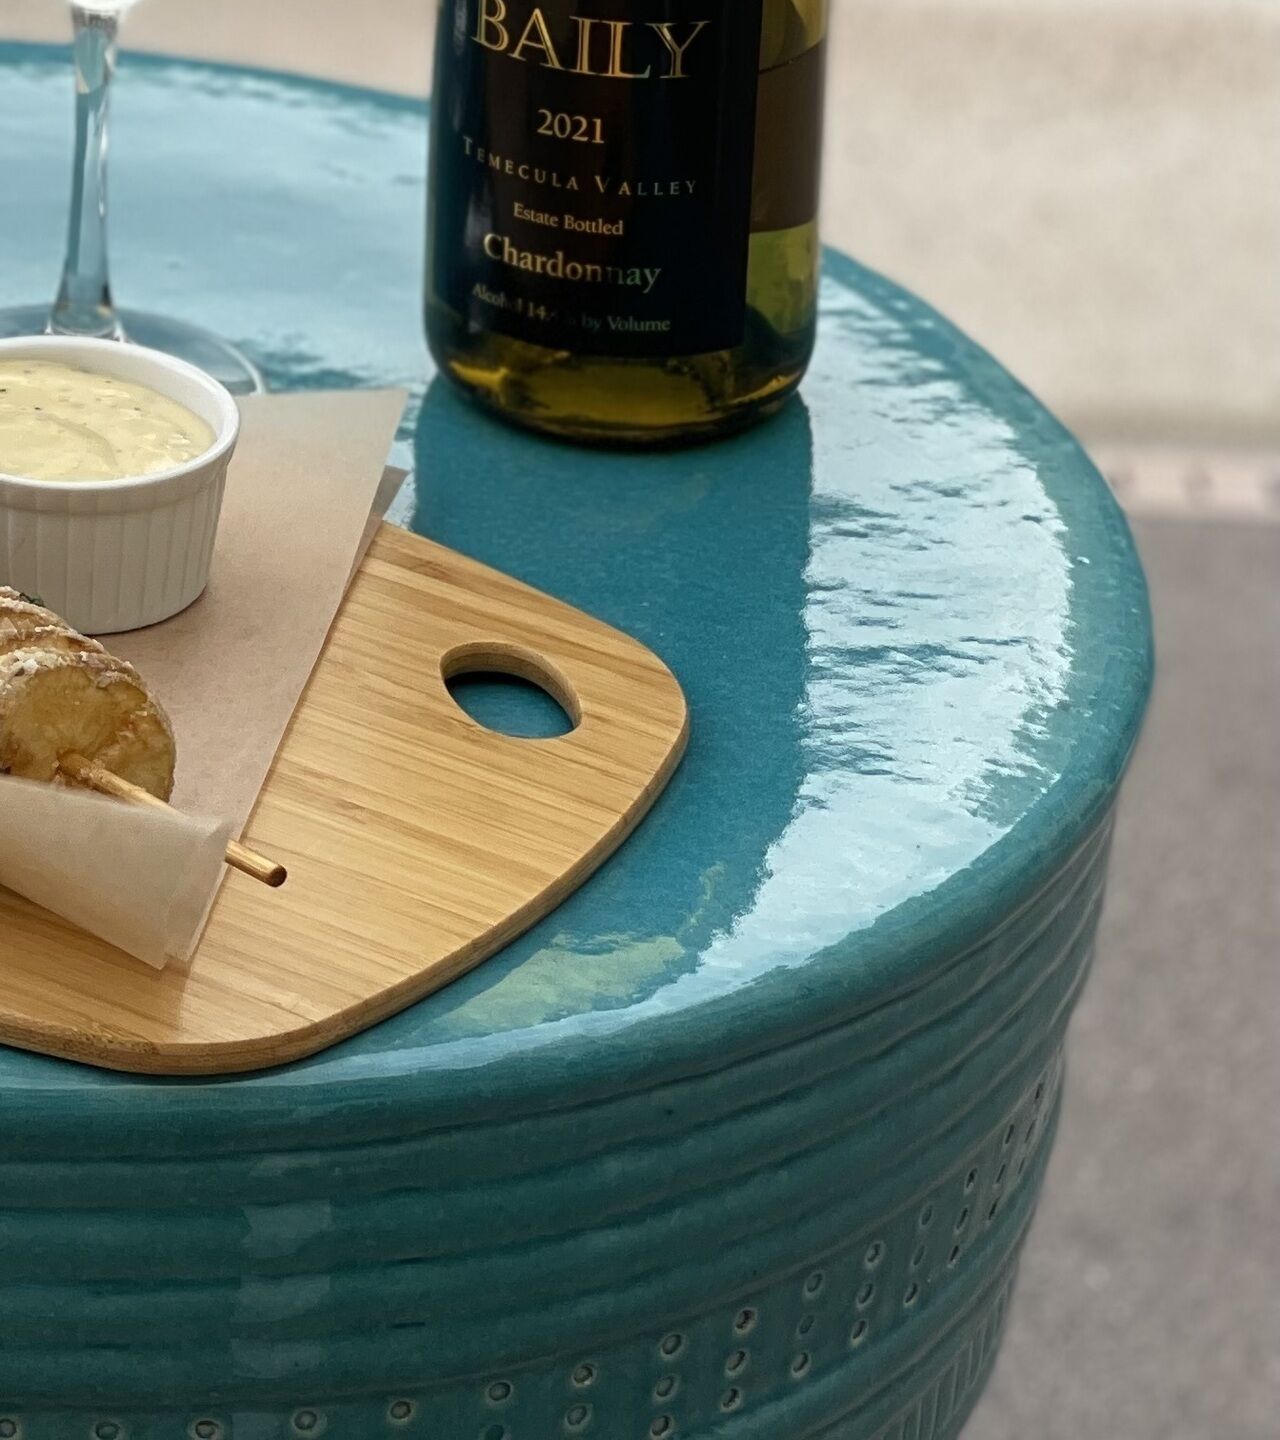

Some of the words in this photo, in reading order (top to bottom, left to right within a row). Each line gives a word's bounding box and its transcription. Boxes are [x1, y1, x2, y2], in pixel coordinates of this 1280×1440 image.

[536, 108, 606, 144] 2021
[462, 135, 580, 191] TEMECULA
[594, 175, 698, 196] VALLEY
[513, 202, 559, 228] Estate
[563, 214, 624, 236] Bottled
[483, 232, 662, 293] Chardonnay
[606, 314, 672, 332] Volume
